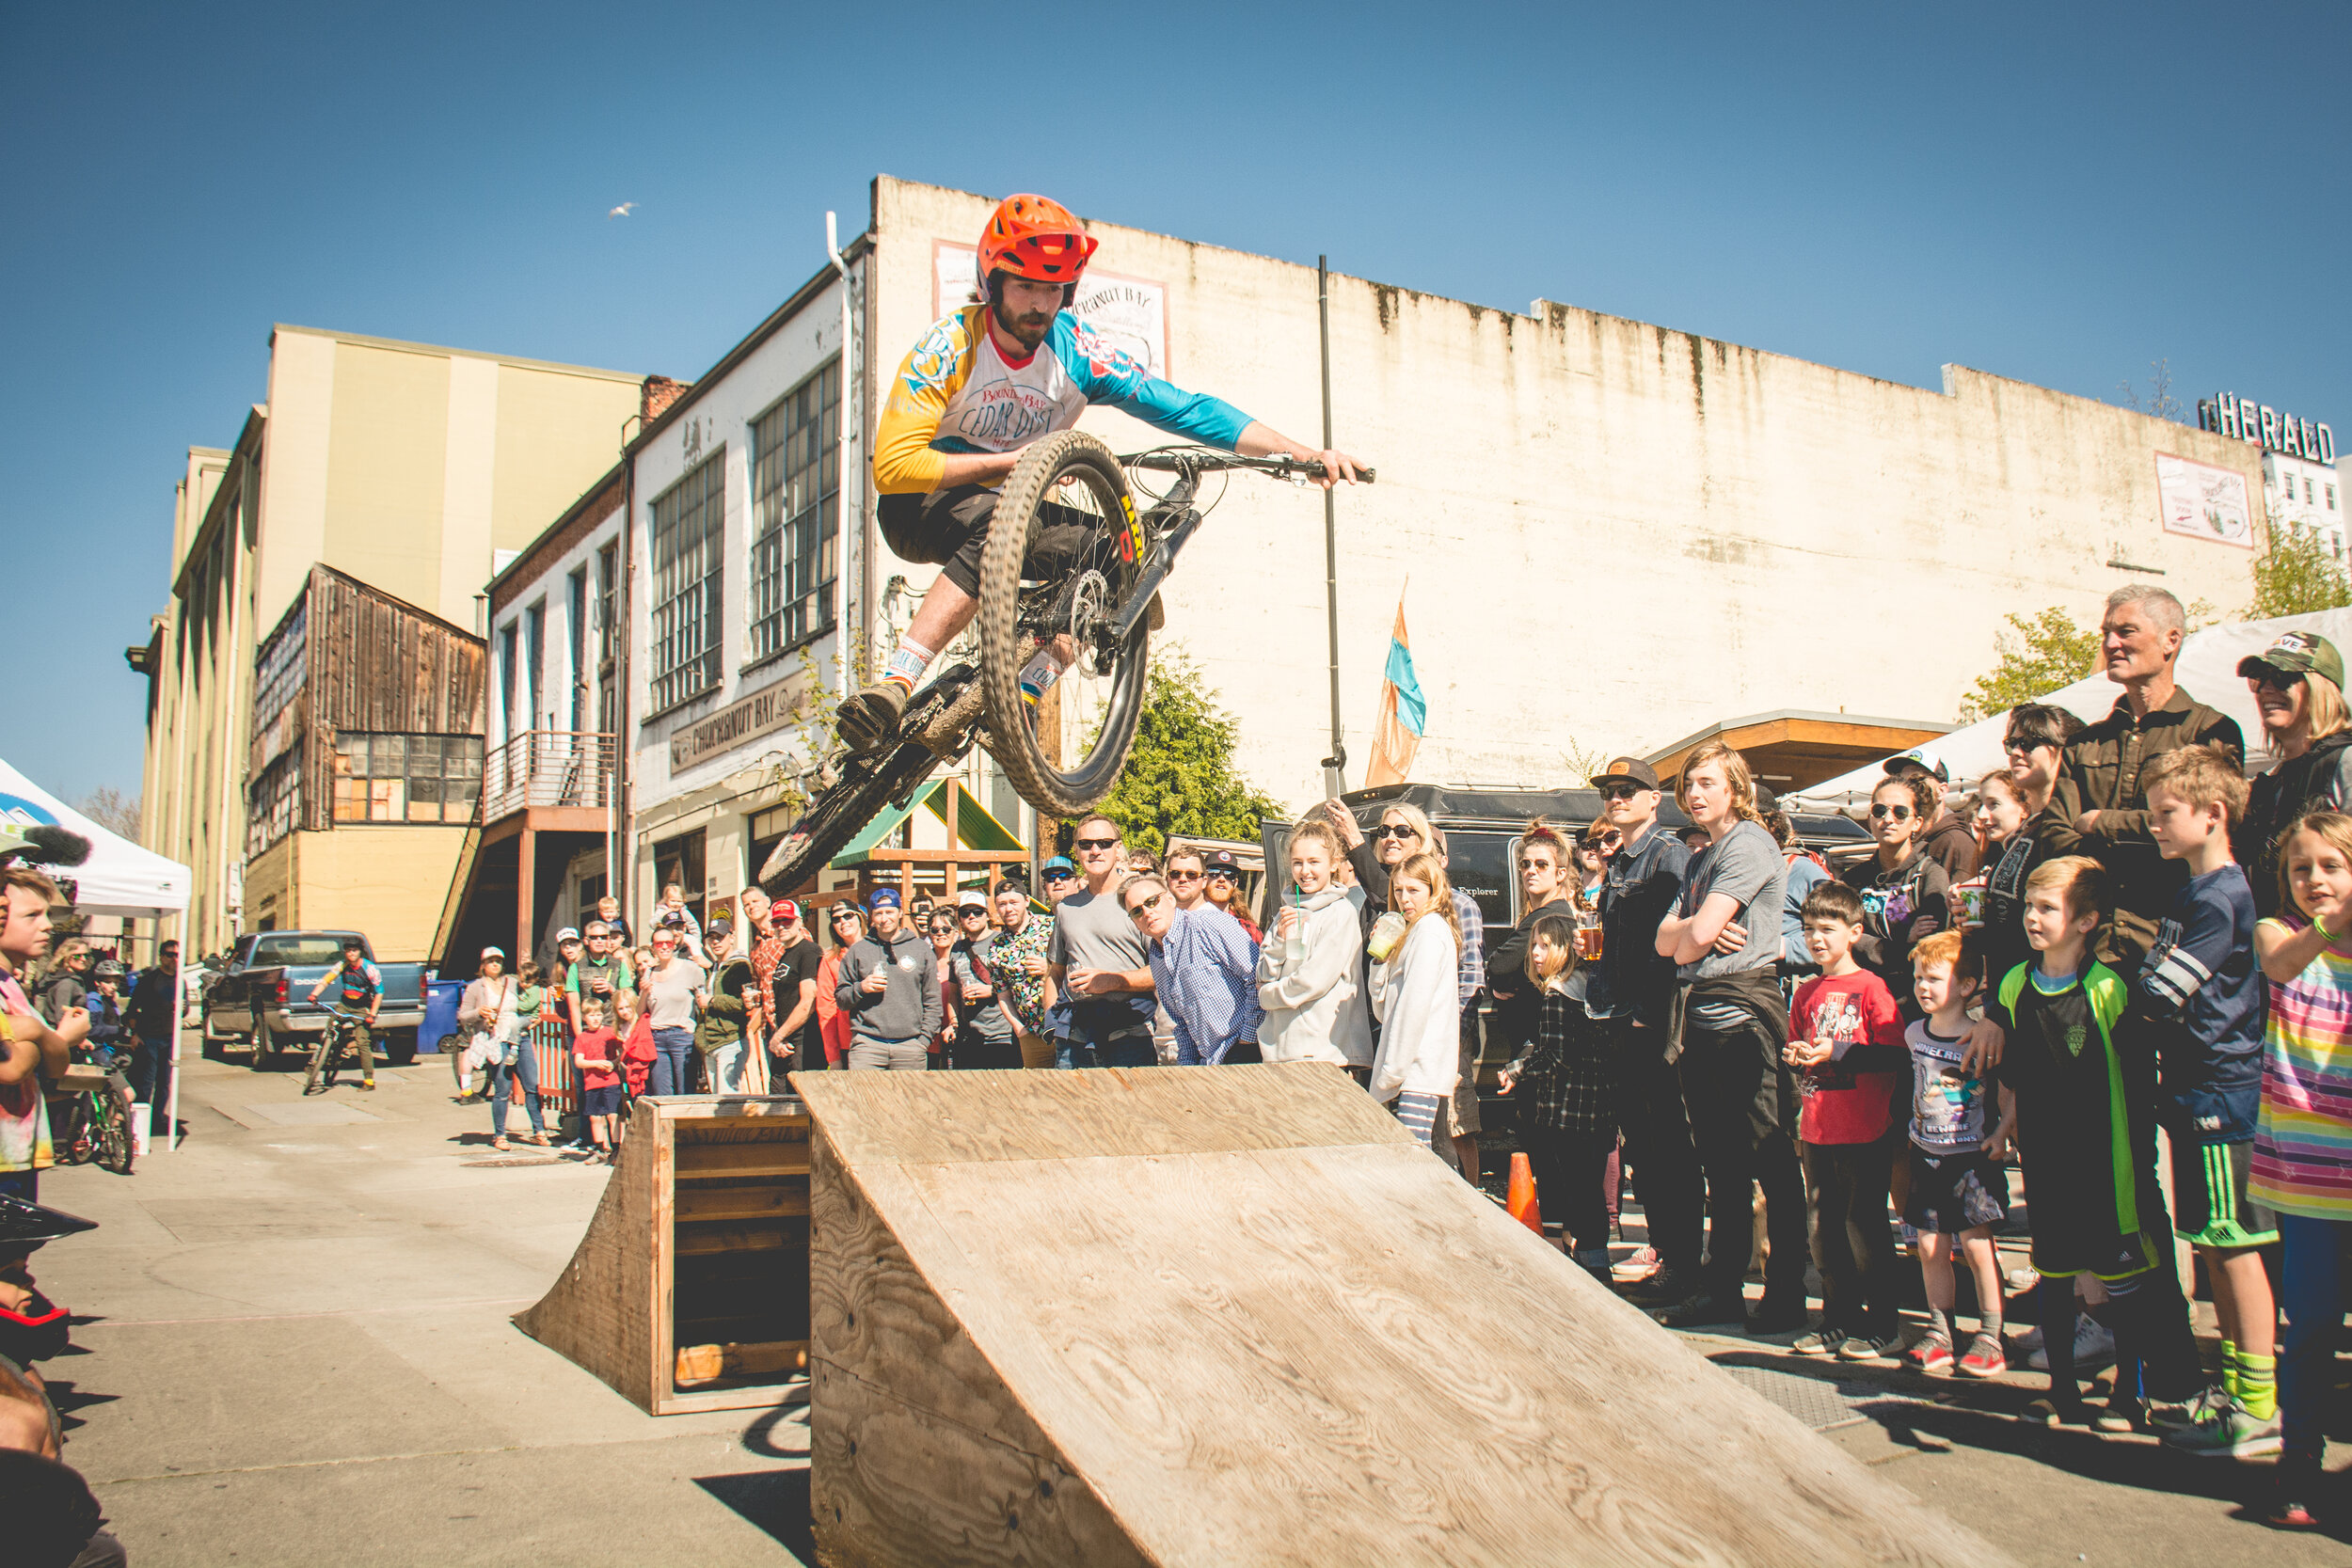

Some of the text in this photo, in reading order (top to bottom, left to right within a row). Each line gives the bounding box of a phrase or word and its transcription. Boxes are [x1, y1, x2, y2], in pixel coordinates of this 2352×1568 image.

[1124, 287, 1151, 308] BAY
[958, 402, 1014, 438] CEDAR
[2216, 391, 2335, 465] HERALD
[691, 703, 752, 755] CHUCKANUT
[755, 691, 776, 729] BAY
[1457, 886, 1499, 897] Explorer
[1913, 1041, 1963, 1063] MINECRA
[1925, 1123, 1971, 1133] BEWARE
